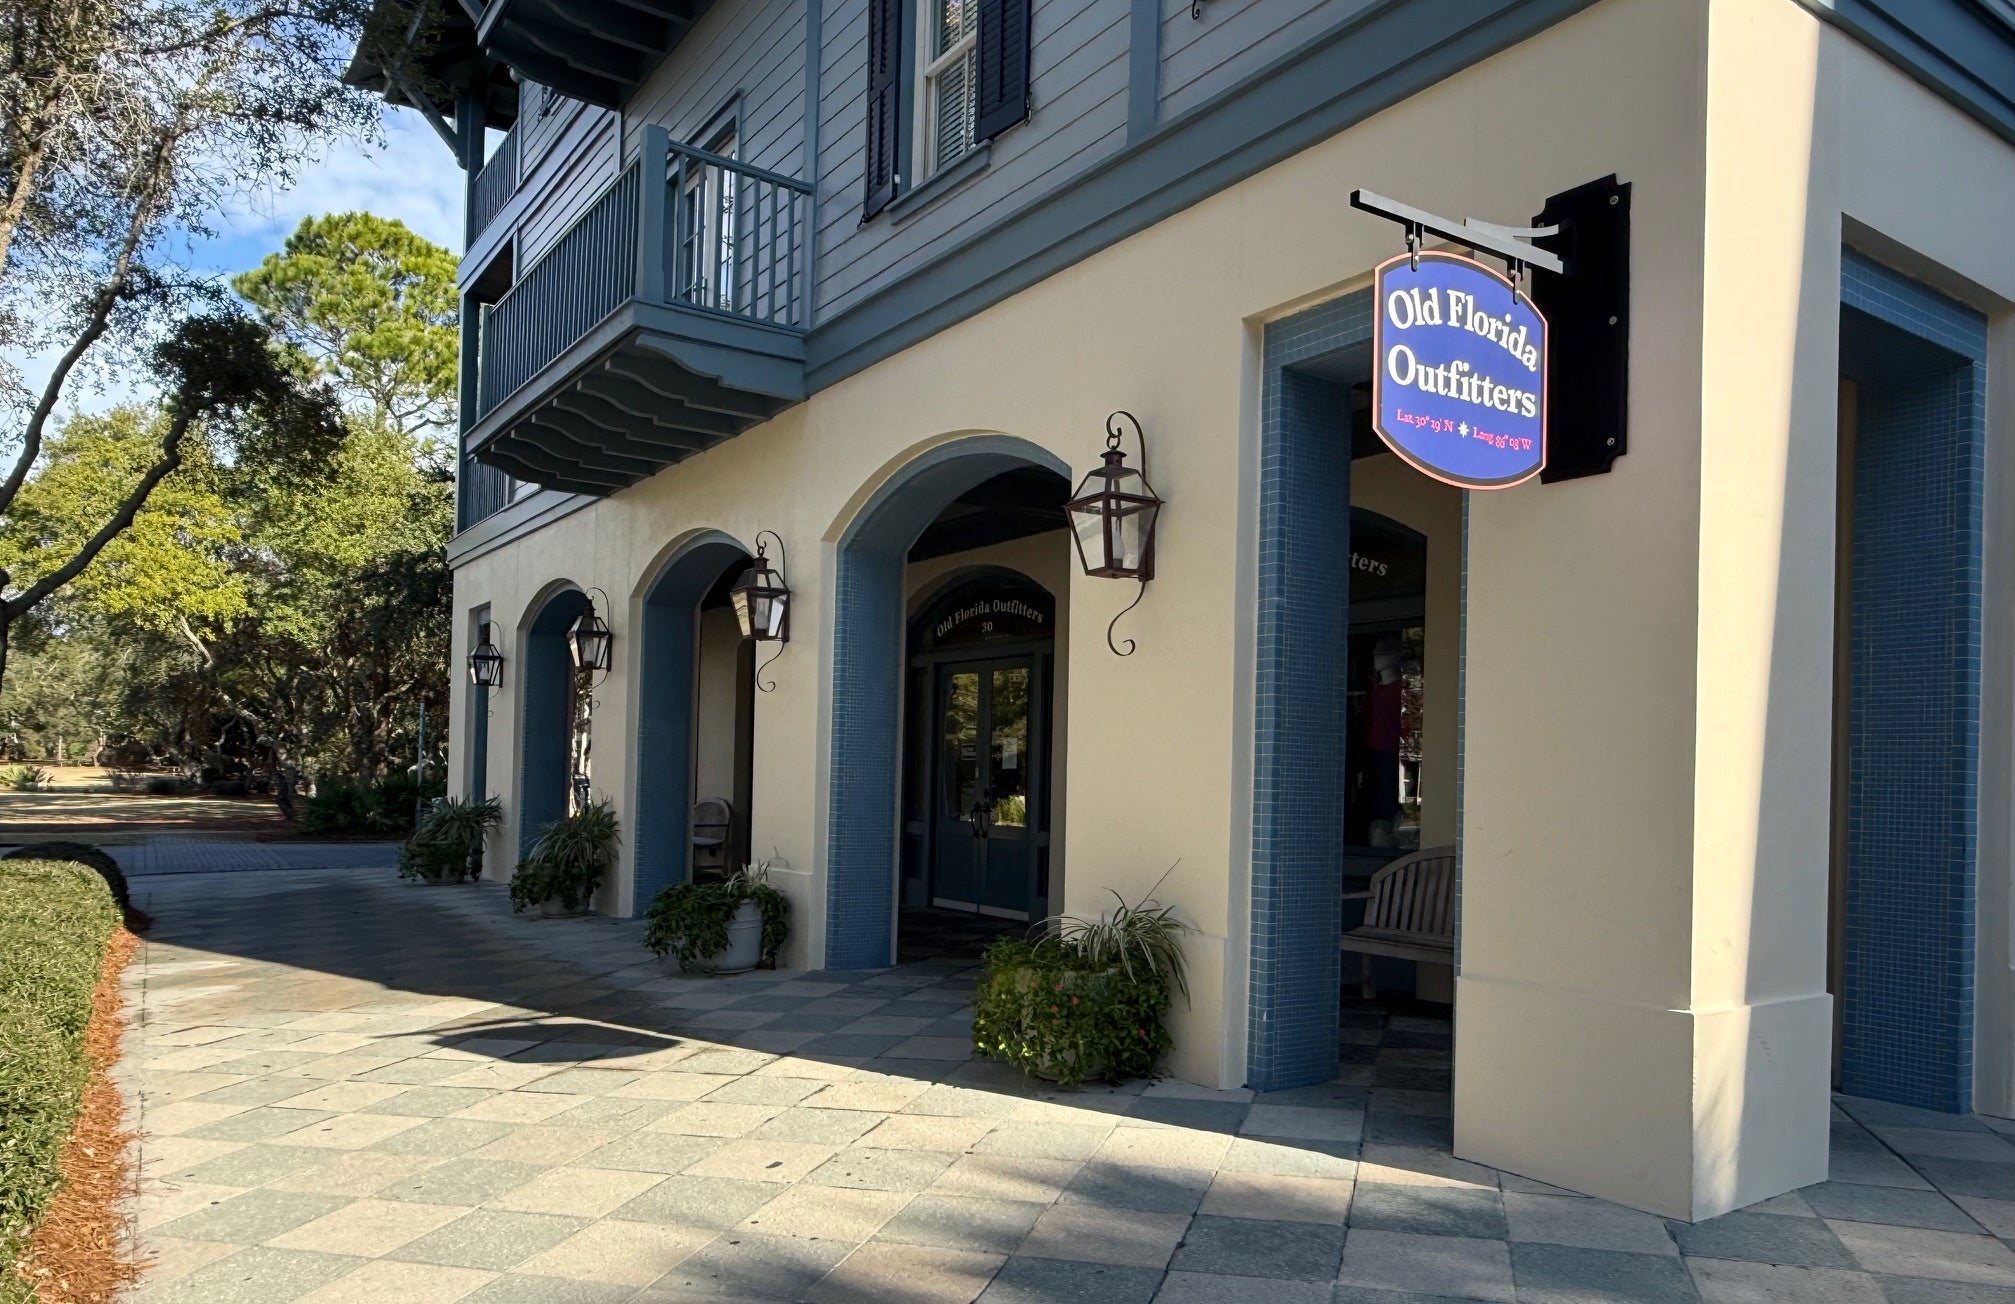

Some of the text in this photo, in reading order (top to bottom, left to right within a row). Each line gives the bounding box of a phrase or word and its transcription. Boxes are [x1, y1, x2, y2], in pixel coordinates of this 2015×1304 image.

[1388, 287, 1537, 372] Old Florida
[1388, 344, 1536, 418] Outfitters
[1443, 419, 1454, 433] N
[1348, 552, 1388, 577] ters
[937, 599, 1043, 637] Old Florida Outfitters
